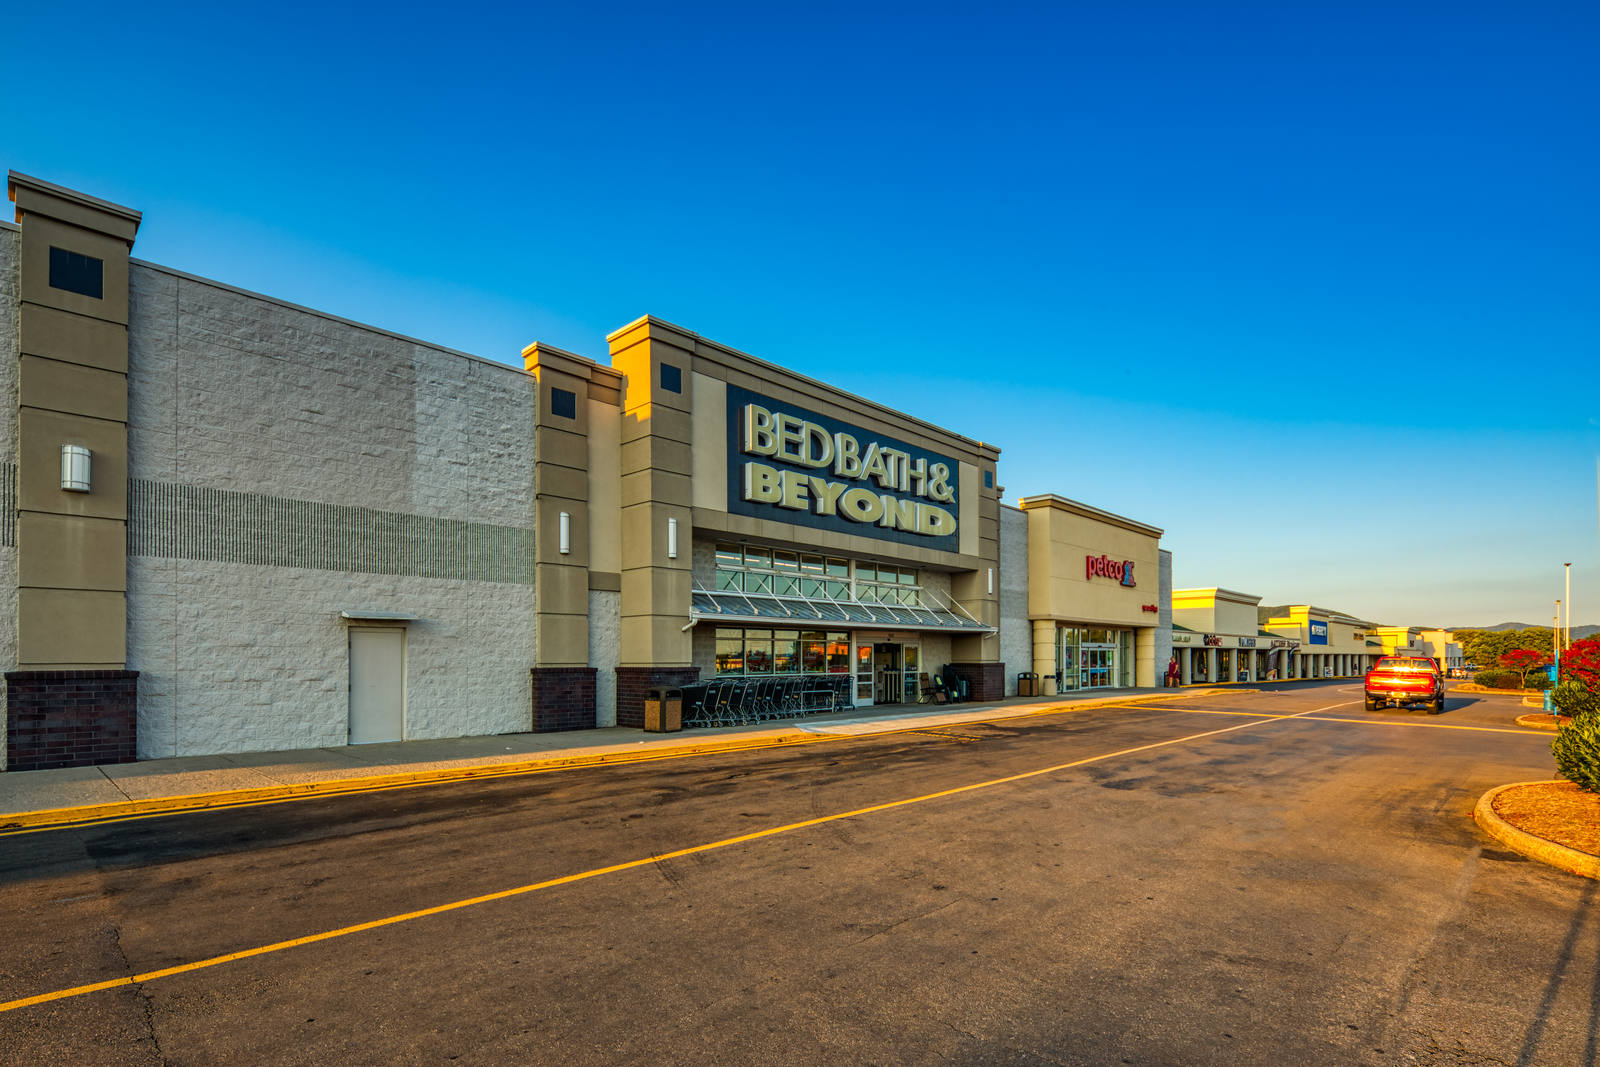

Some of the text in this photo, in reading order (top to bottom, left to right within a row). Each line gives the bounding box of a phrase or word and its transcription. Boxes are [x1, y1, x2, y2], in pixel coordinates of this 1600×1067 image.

[745, 403, 956, 504] BED BATH &
[745, 462, 957, 536] BEYOND
[1086, 554, 1123, 581] petco
